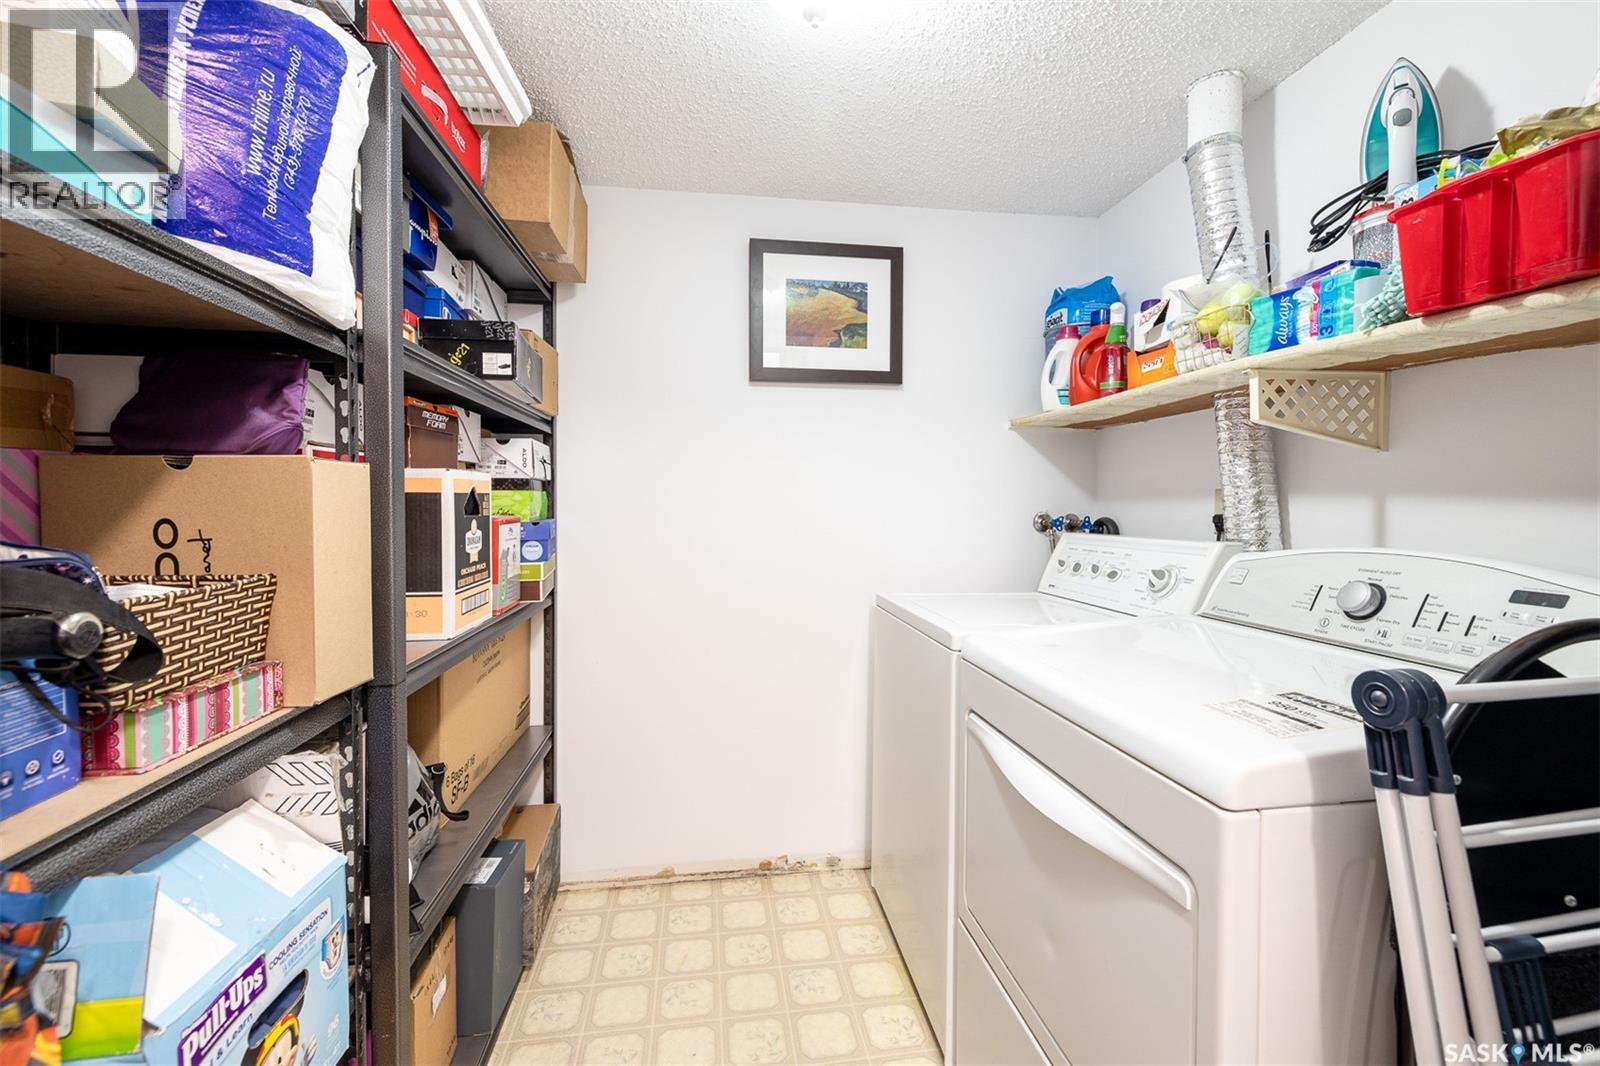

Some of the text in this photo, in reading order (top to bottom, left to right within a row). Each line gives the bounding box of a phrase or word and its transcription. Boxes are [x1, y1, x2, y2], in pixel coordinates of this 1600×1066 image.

[248, 67, 276, 176] www.triline.ru
[262, 162, 282, 220] Телефон
[1275, 296, 1293, 345] always
[421, 410, 449, 424] MEMORY
[426, 419, 447, 430] FOAM
[268, 937, 298, 970] COOLING
[299, 908, 329, 940] SENSATION
[226, 1012, 253, 1047] Learn
